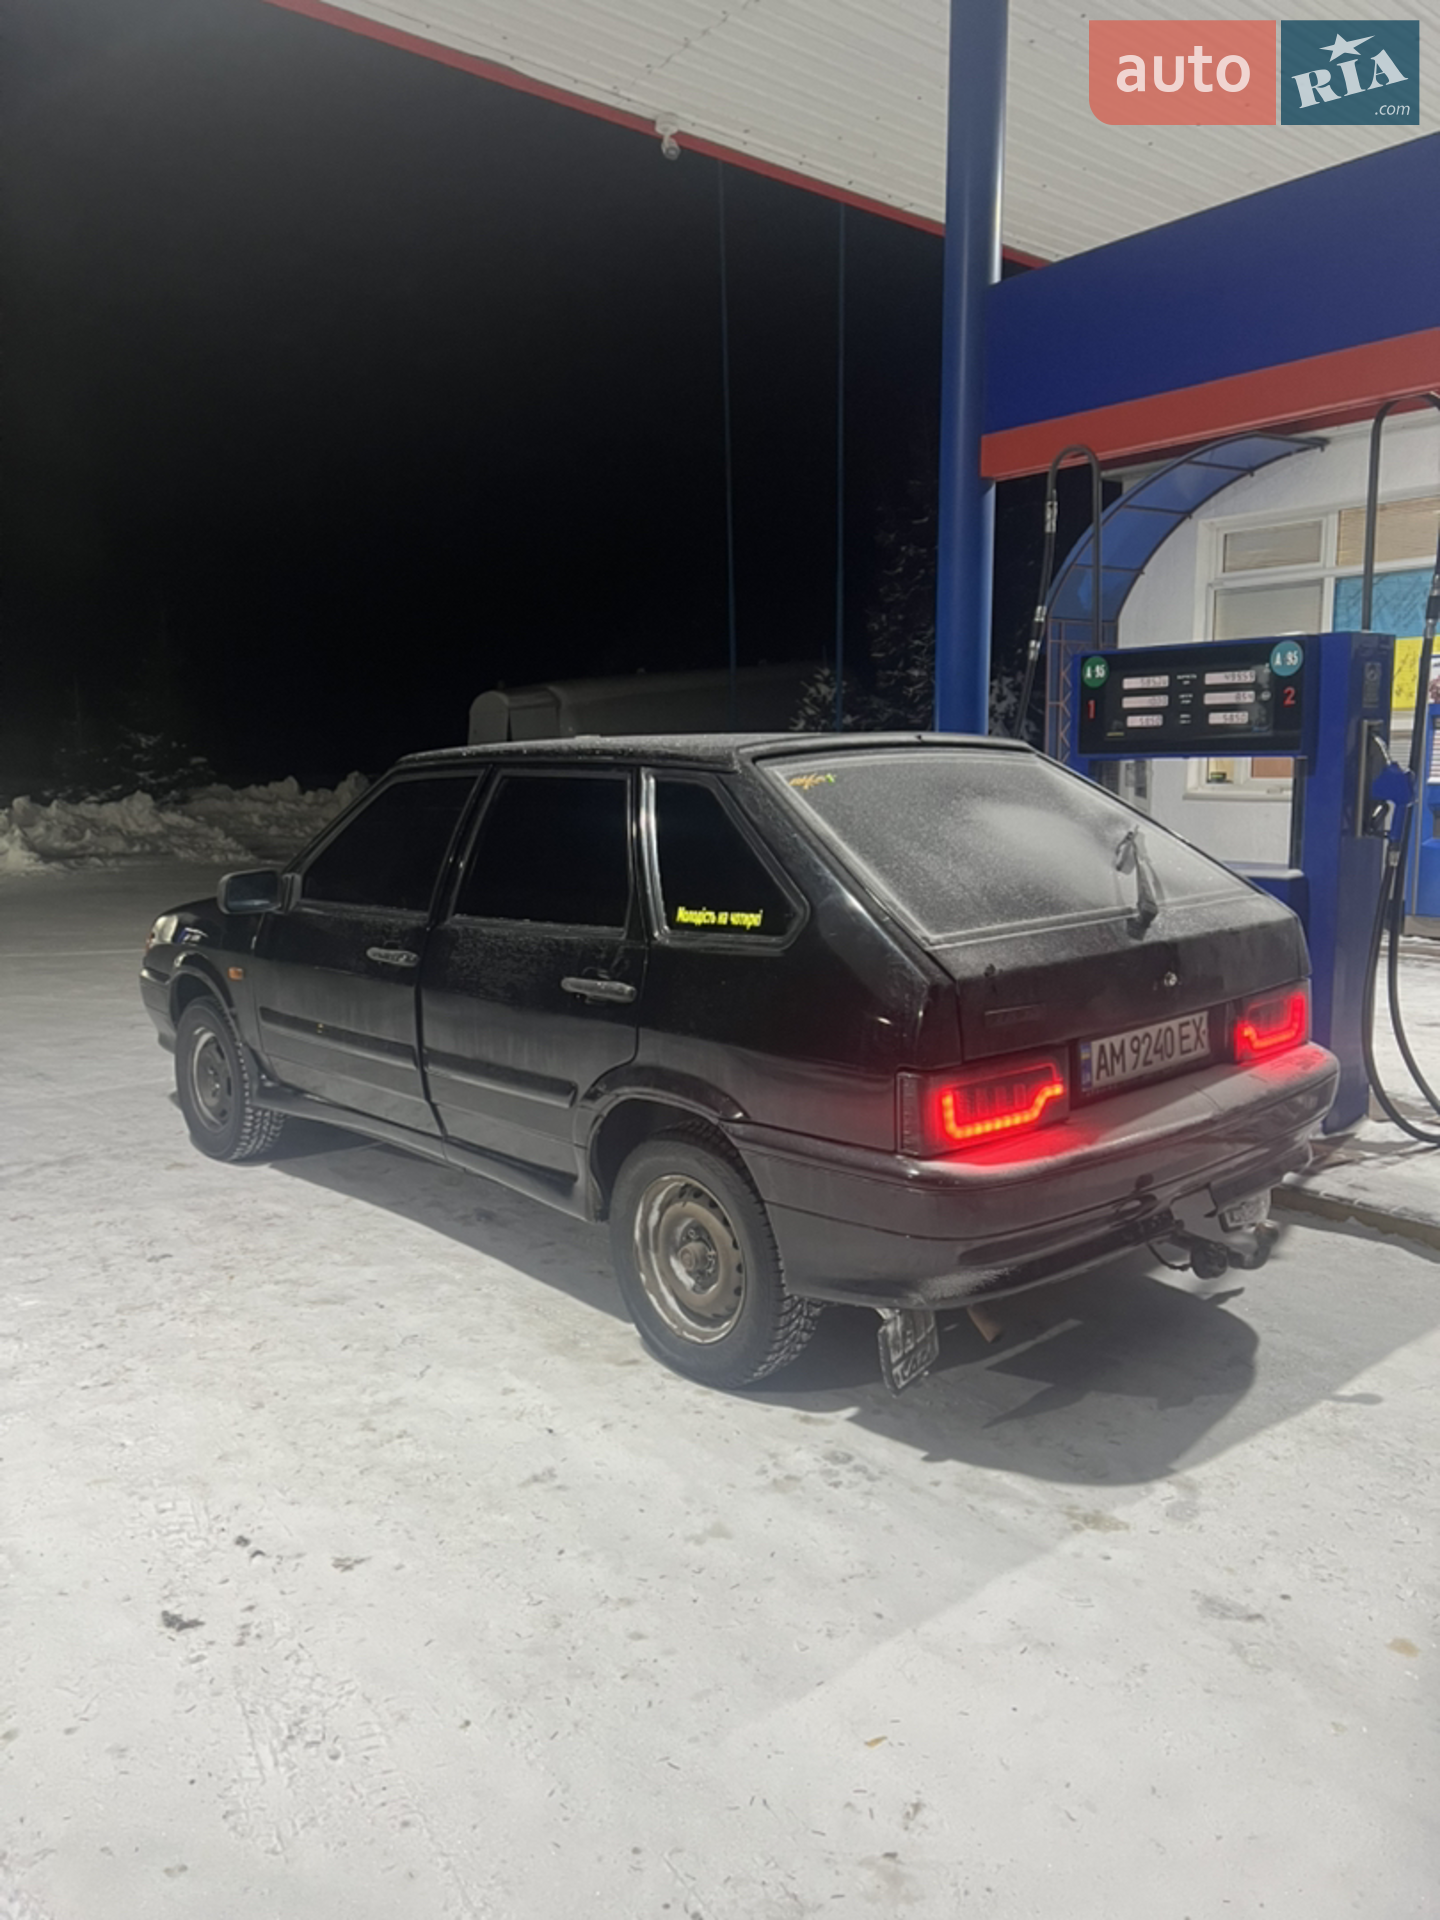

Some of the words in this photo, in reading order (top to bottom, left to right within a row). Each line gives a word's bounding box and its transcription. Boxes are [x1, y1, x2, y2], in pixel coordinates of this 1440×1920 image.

[1283, 686, 1296, 706] 2
[1087, 700, 1096, 719] 1
[1096, 1038, 1126, 1081] AM
[1130, 1025, 1175, 1071] 9240
[1179, 1016, 1205, 1055] EX
